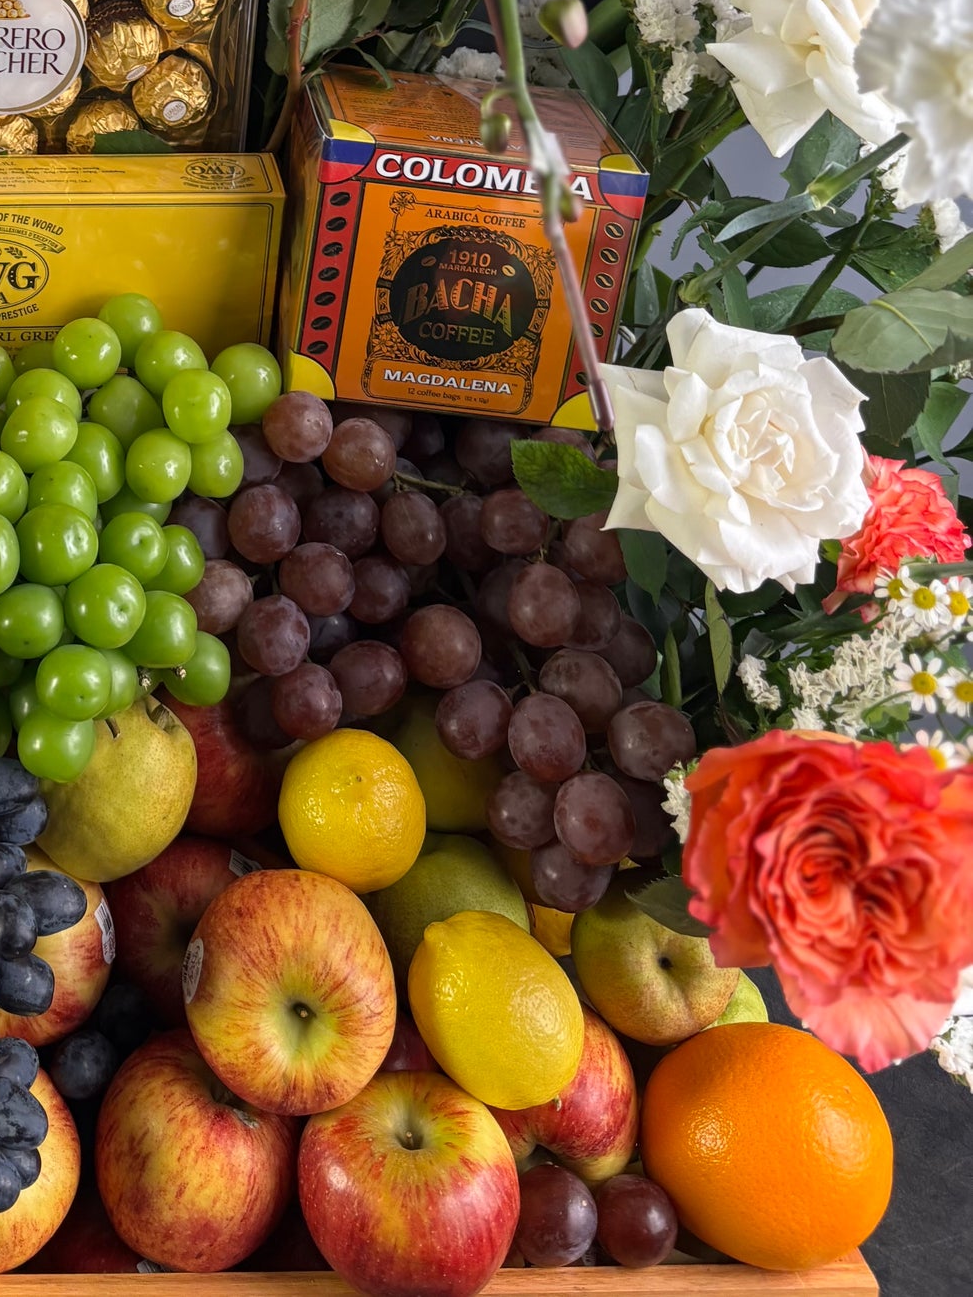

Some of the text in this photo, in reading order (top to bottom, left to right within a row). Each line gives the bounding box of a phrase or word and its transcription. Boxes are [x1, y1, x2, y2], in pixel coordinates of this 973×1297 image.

[189, 165, 241, 175] TWG
[375, 152, 594, 201] COLOMA
[11, 213, 31, 225] THE
[31, 217, 64, 236] WORLD
[425, 208, 527, 229] ARABICA COFFEE
[438, 262, 498, 276] MARRAKECH
[449, 249, 492, 268] 1910
[403, 278, 513, 338] BACHA
[418, 321, 496, 346] COFFEE
[407, 387, 416, 395] 12
[416, 388, 441, 398] coffee
[442, 391, 461, 402] bags
